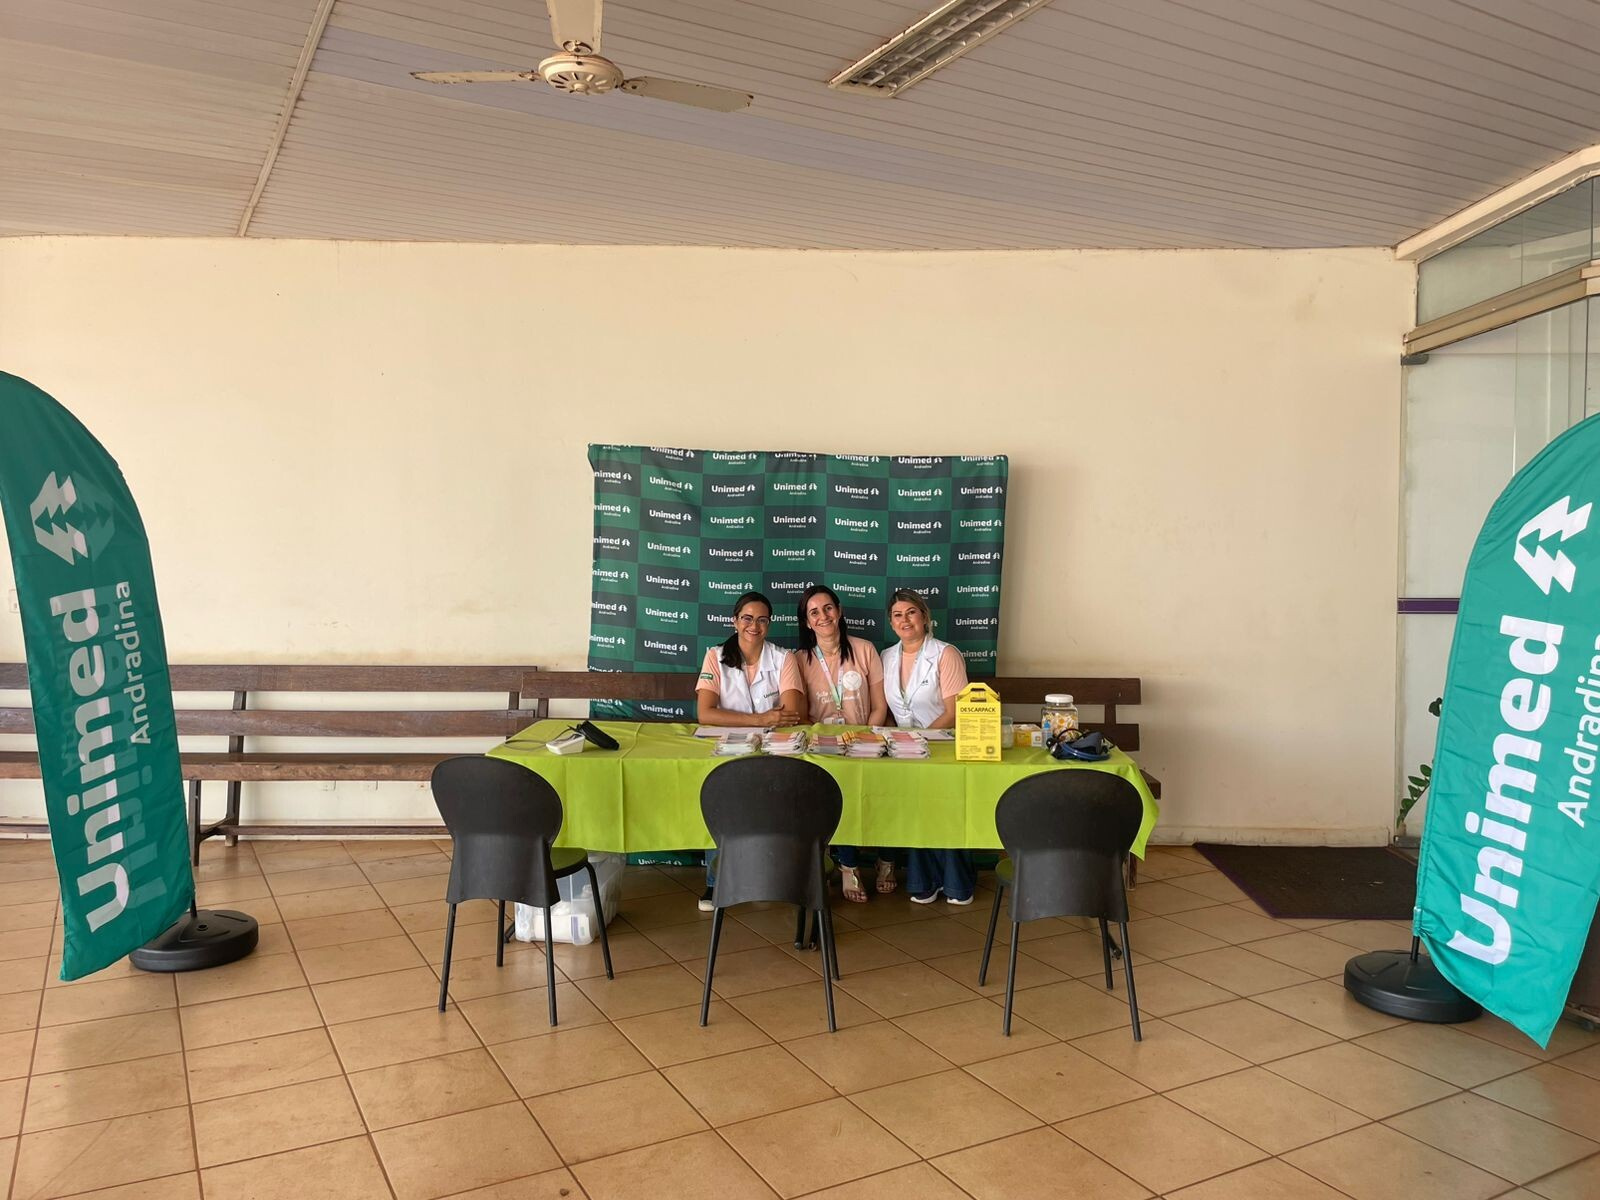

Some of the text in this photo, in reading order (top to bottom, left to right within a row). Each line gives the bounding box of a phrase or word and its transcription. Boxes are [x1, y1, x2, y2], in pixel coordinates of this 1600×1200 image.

[650, 446, 684, 457] Unimed
[712, 452, 747, 460] Unimed
[835, 454, 869, 462] Unimed
[898, 456, 932, 464] Unimed
[594, 470, 621, 479] nimed
[649, 476, 683, 489] Unimed
[773, 483, 807, 491] Unimed
[711, 485, 746, 493] Unimed
[834, 484, 869, 495] Unimed
[897, 489, 932, 497] Unimed
[960, 486, 994, 495] Unimed
[649, 509, 682, 520] Unimed
[710, 516, 745, 524] Unimed
[772, 515, 807, 524] Unimed
[834, 517, 868, 528] Unimed
[960, 519, 992, 528] Unimed
[897, 521, 932, 529] Unimed
[593, 536, 620, 545] nimed
[647, 542, 681, 553] Unimed
[708, 548, 744, 557] Unimed
[772, 548, 806, 557] Unimed
[833, 550, 867, 561] Unimed
[958, 552, 991, 561] Unimed
[896, 554, 931, 562] Unimed
[592, 568, 619, 578] nimed
[646, 575, 680, 586] Unimed
[771, 581, 805, 589] Unimed
[708, 581, 743, 590] Unimed
[833, 584, 866, 593] Unimed
[956, 585, 990, 593] Unimed
[645, 607, 678, 619] Unimed
[955, 617, 989, 626] Unimed
[644, 640, 678, 651] Unimed
[114, 581, 152, 745] Andradina
[640, 704, 674, 714] Unimed
[1557, 634, 1600, 828] Andradin
[50, 588, 130, 933] Unimed
[1446, 615, 1564, 966] Unimed
